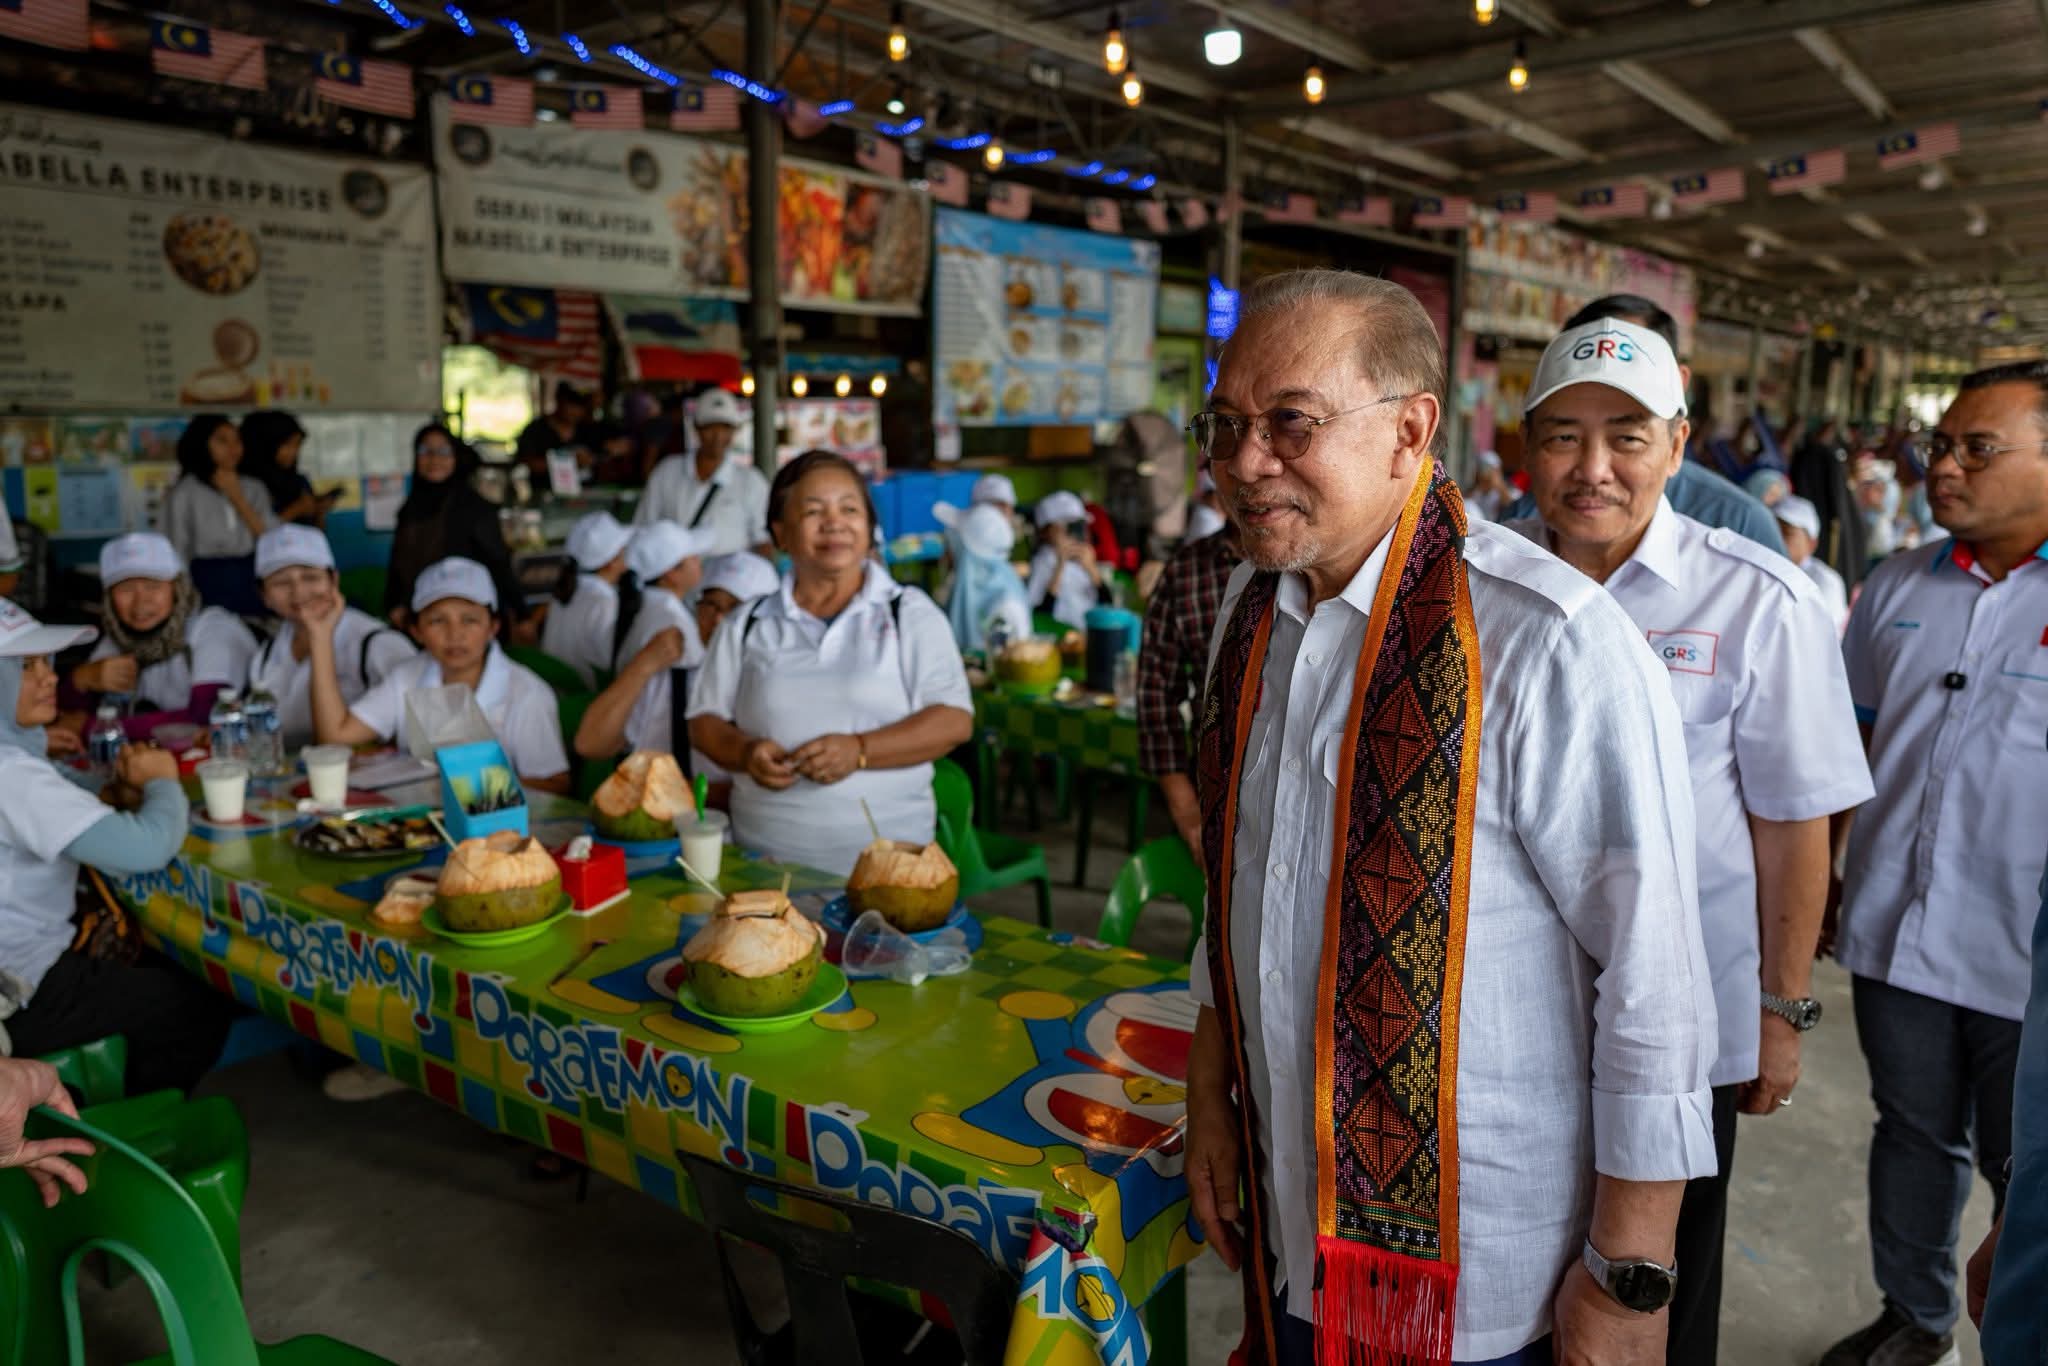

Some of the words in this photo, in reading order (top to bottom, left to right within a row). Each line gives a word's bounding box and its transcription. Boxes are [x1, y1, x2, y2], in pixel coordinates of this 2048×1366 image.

[141, 167, 331, 213] ENTERPRISE
[557, 206, 654, 235] MALAYSIA
[561, 237, 671, 268] ENTERPRISE
[0, 291, 68, 313] LAPA
[1573, 339, 1634, 362] GRS
[1663, 646, 1696, 661] GRS
